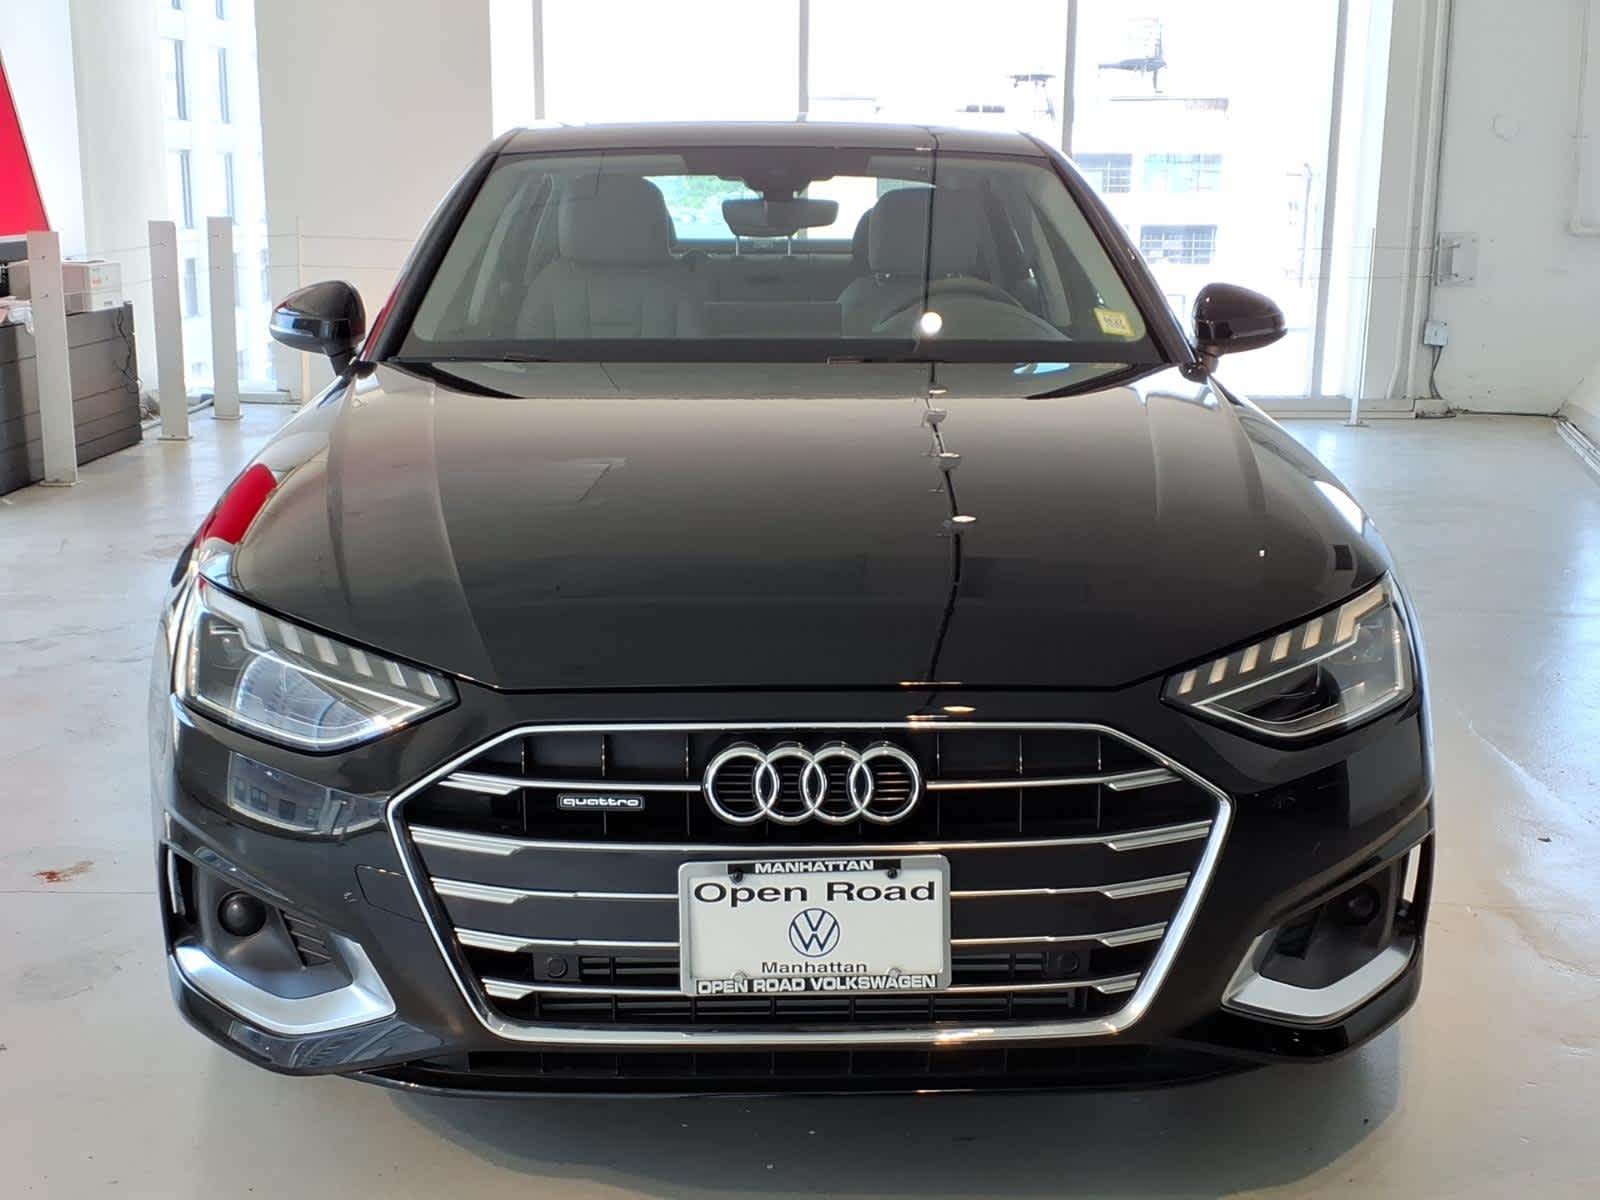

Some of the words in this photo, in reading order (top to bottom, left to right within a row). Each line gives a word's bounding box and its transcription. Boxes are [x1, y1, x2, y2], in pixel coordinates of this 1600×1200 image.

[563, 797, 639, 807] quattro
[755, 860, 874, 874] MANHATTAN
[694, 882, 808, 907] Open
[827, 881, 935, 901] Road
[762, 961, 867, 973] Manhattan
[698, 979, 748, 994] OPEN
[753, 978, 806, 992] ROAD
[810, 975, 936, 990] VOLKSWAGEN
